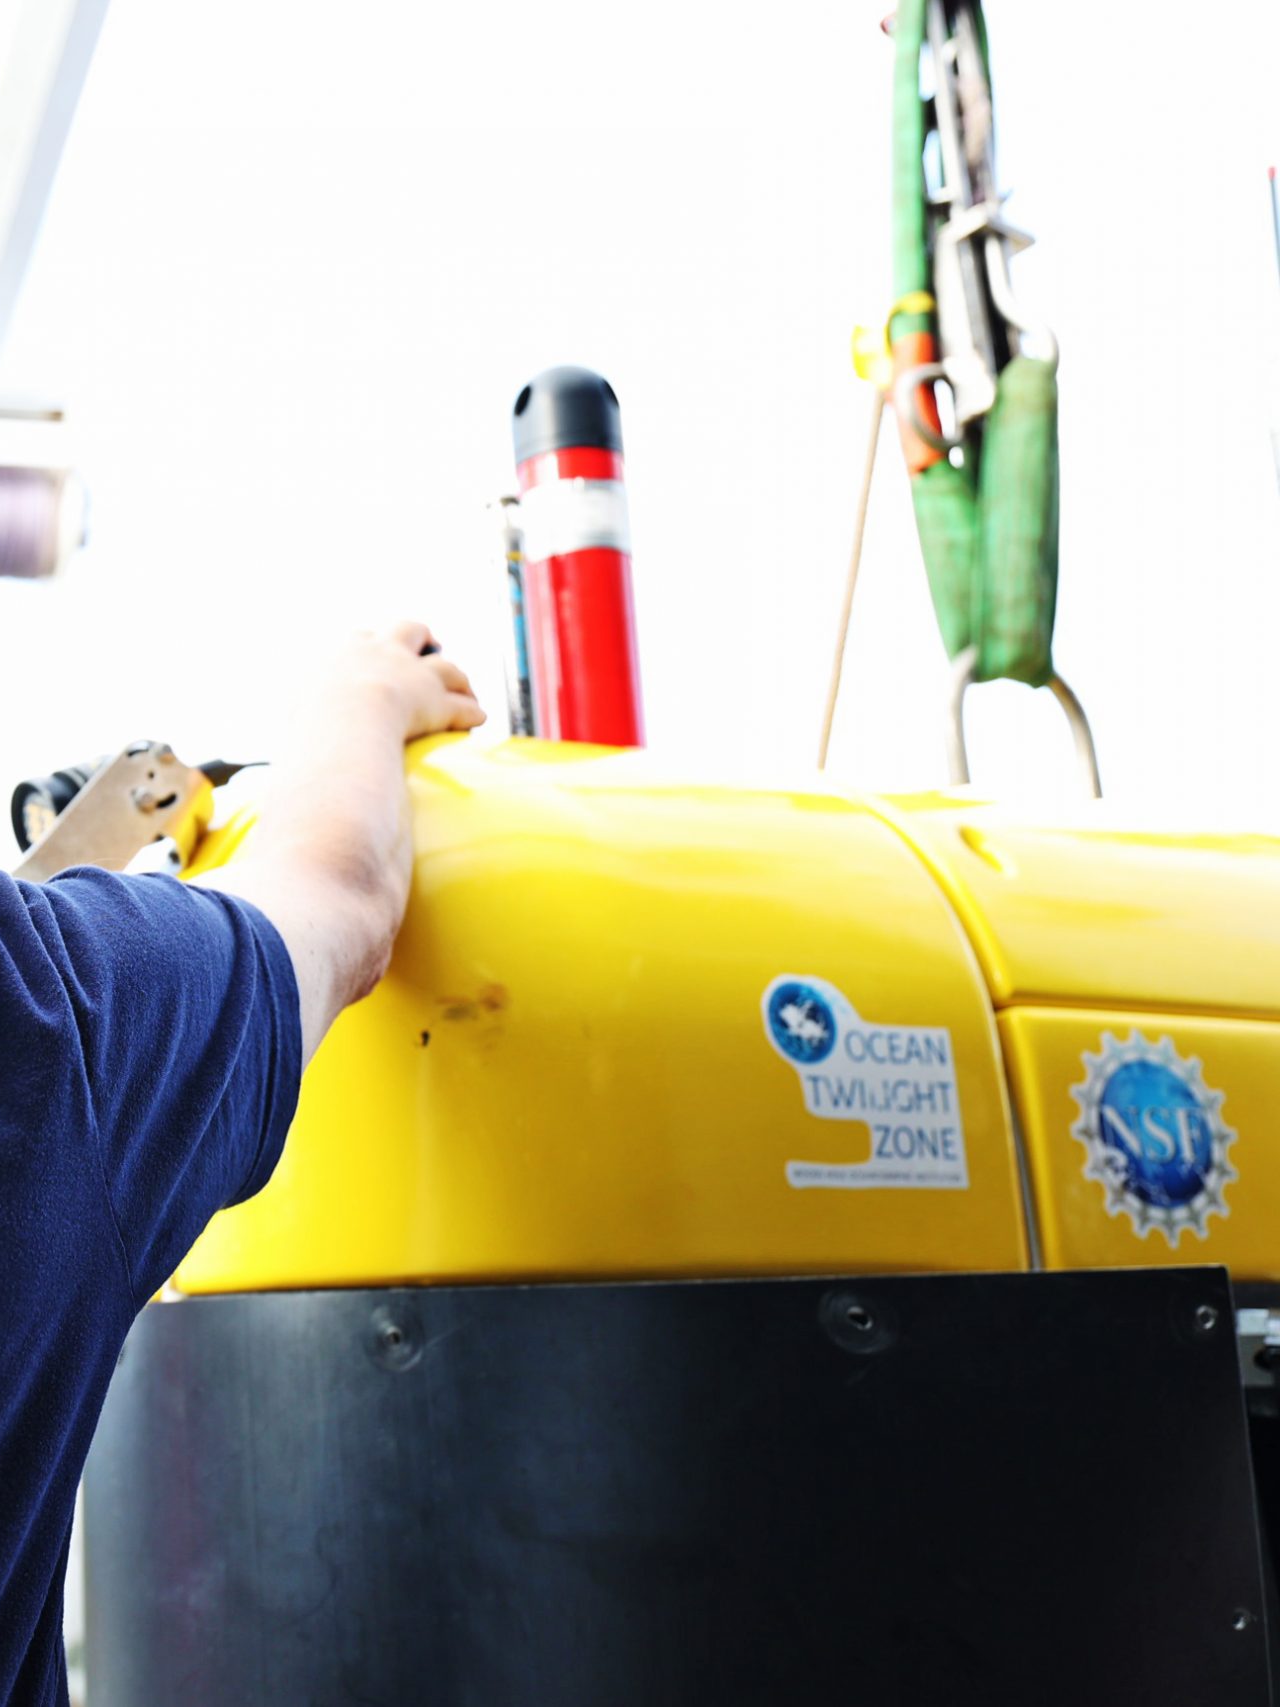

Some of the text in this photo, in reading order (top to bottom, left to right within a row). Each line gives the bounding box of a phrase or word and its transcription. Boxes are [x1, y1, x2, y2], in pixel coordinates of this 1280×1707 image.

[844, 1029, 948, 1066] OCEAN
[806, 1074, 952, 1114] TWILIGHT
[873, 1124, 958, 1162] ZONE
[1100, 1105, 1206, 1167] NSF
